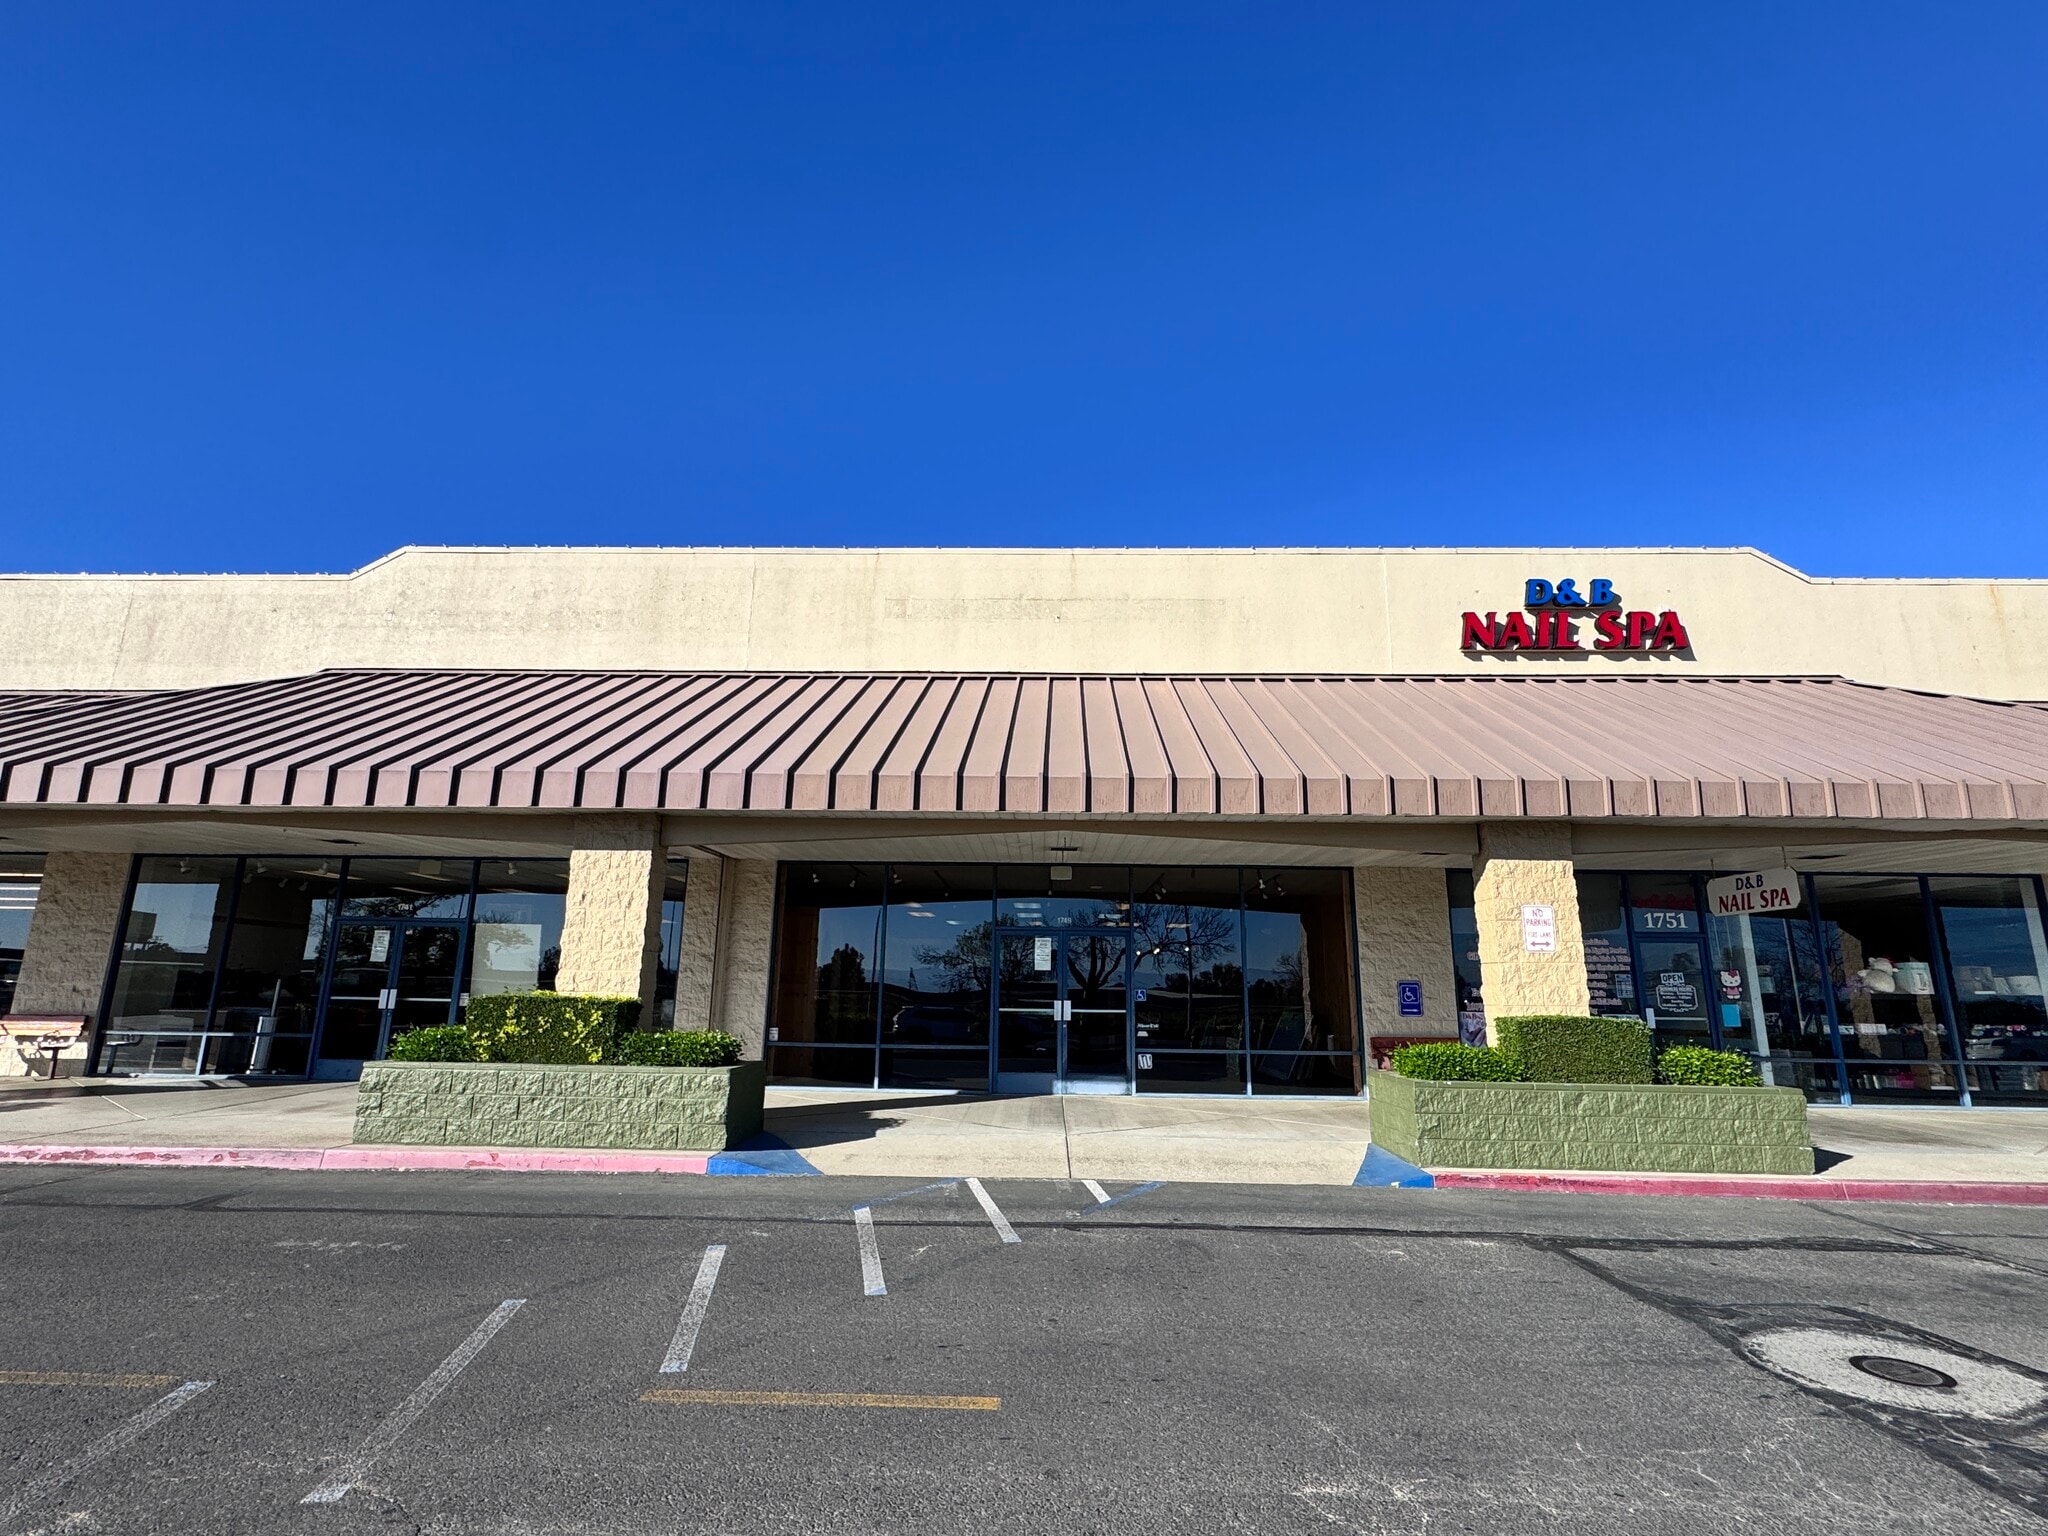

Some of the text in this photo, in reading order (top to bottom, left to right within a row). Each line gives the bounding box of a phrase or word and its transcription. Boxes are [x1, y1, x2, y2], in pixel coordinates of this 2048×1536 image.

[1525, 578, 1616, 607] D&B
[1460, 610, 1690, 650] NAIL SPA
[1735, 874, 1764, 890] D&B
[1718, 892, 1755, 913] NAIL
[1760, 887, 1791, 908] SPA
[1532, 909, 1543, 917] NO
[1643, 912, 1688, 928] 1751
[1526, 918, 1551, 927] PARKING
[1662, 974, 1683, 982] OPEN
